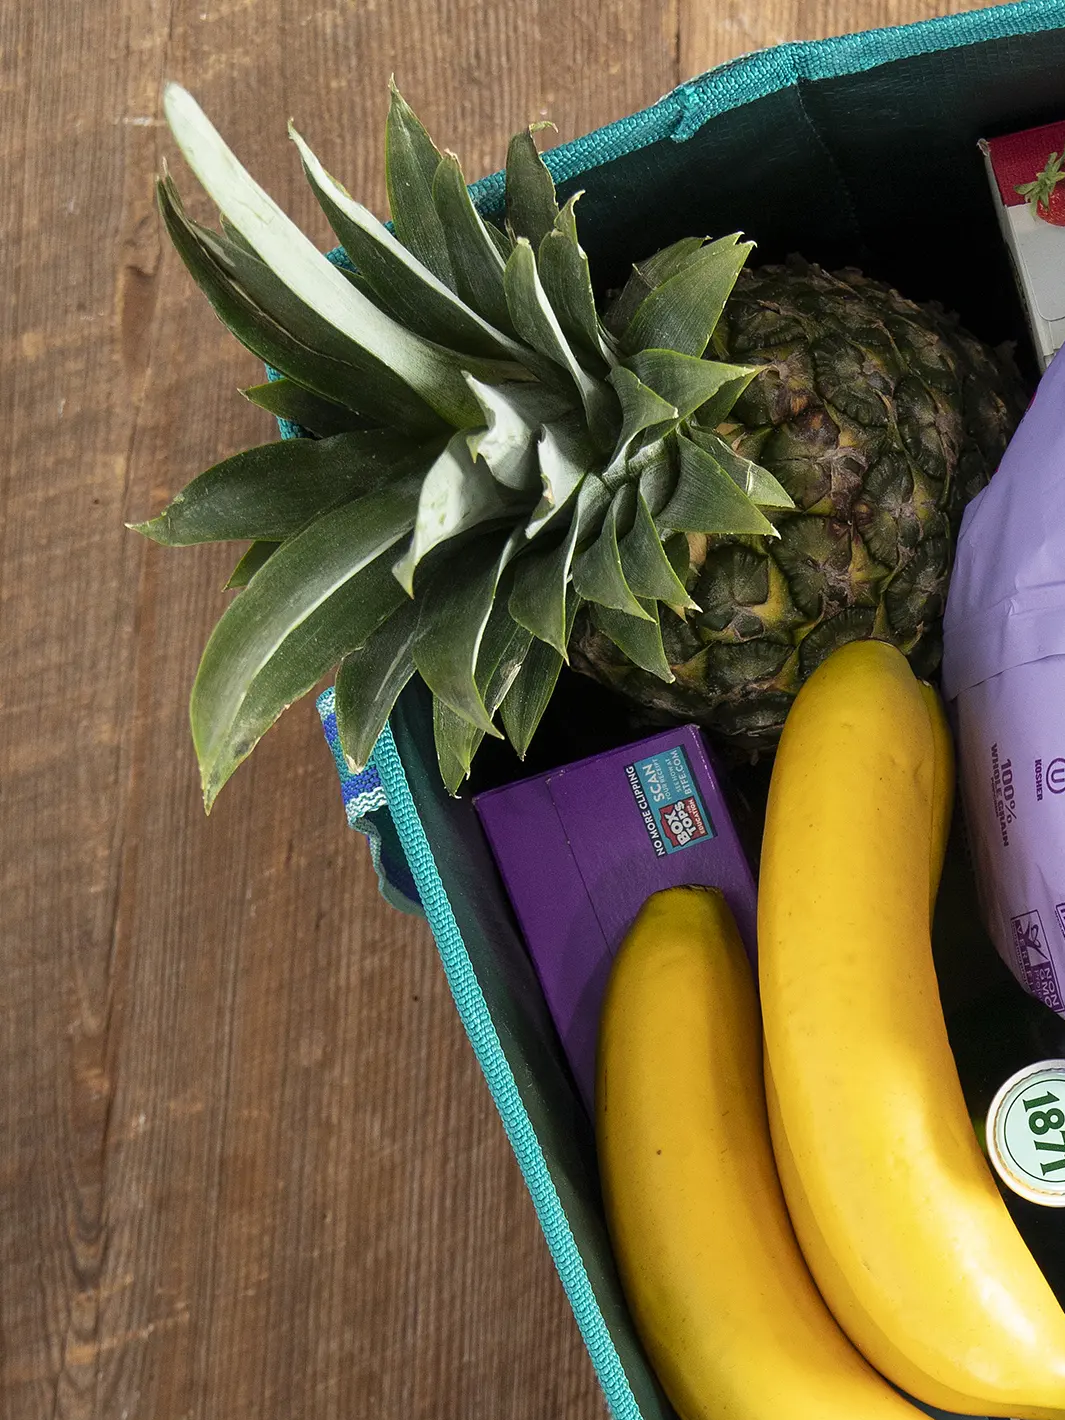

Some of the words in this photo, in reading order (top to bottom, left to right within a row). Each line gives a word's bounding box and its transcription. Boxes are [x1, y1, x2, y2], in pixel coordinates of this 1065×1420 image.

[626, 766, 648, 810] CLIPPING
[642, 763, 665, 802] SCAN
[670, 749, 692, 795] BTFE.COM
[1001, 759, 1017, 824] 100%
[1034, 759, 1043, 801] KOSHER
[642, 810, 659, 839] MORE
[664, 810, 691, 845] BOX
[674, 801, 697, 836] TOPS
[654, 840, 665, 856] NO
[1044, 967, 1060, 1006] NON
